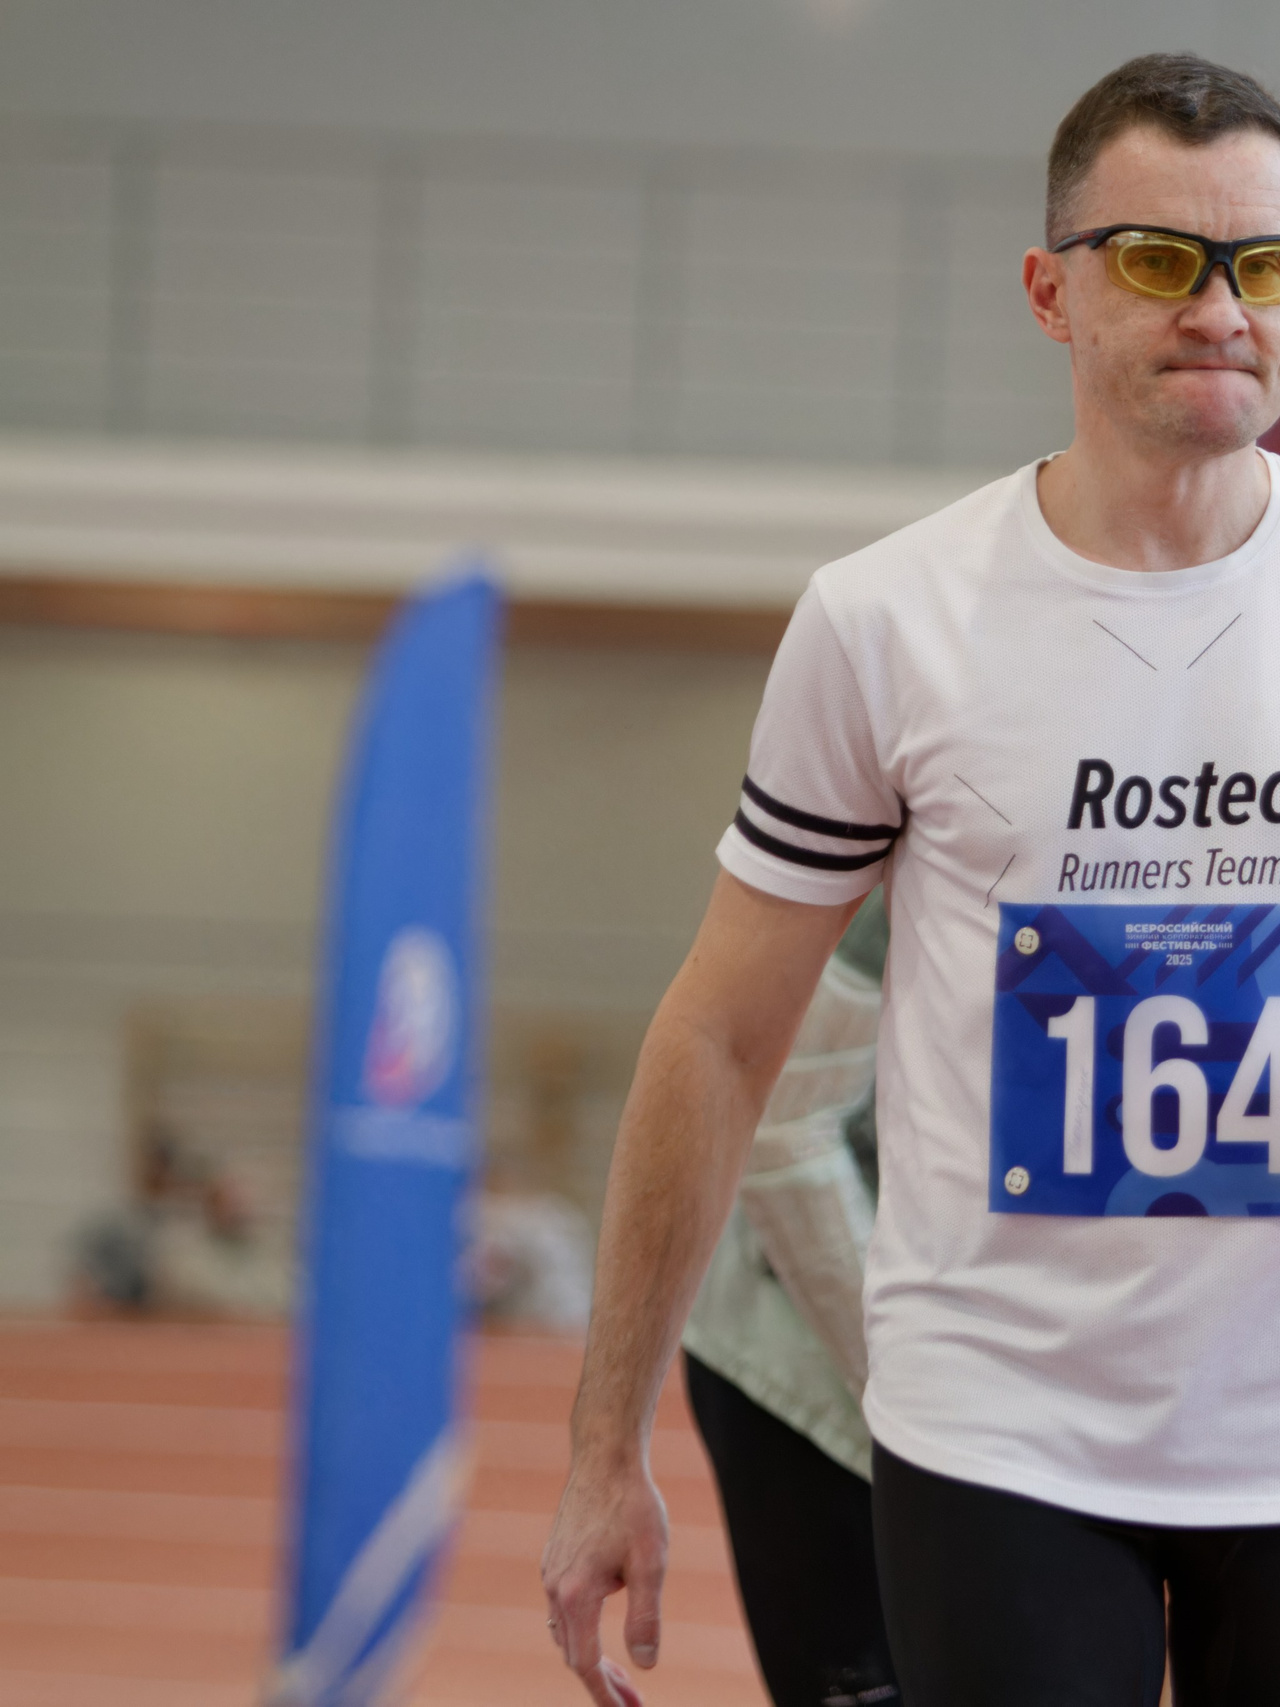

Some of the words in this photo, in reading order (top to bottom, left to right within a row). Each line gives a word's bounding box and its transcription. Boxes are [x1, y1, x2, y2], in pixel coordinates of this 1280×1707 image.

[1058, 853, 1193, 892] Runners
[1125, 922, 1233, 933] ВСЕРОССИЙСКИЙ
[1141, 940, 1217, 951] ФЕСТИВАЛЬ
[1165, 954, 1193, 966] 2025
